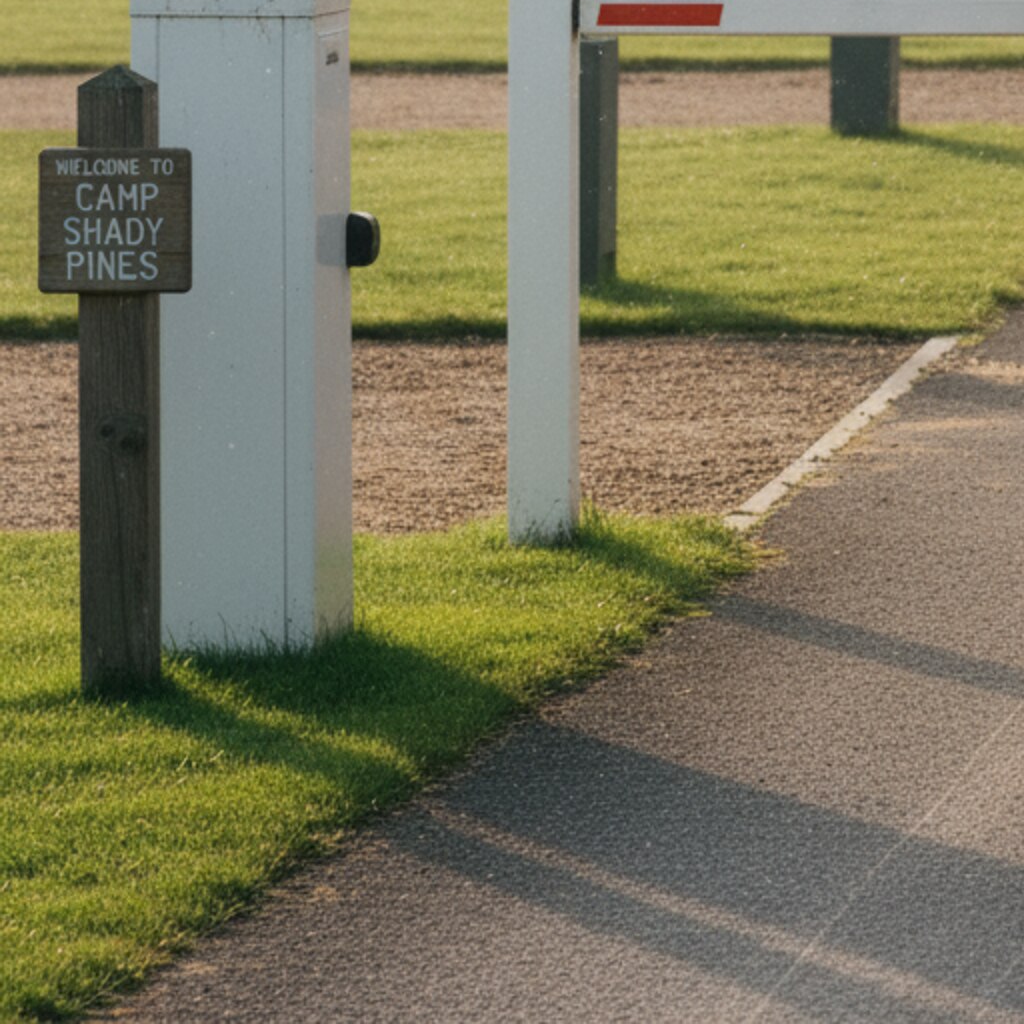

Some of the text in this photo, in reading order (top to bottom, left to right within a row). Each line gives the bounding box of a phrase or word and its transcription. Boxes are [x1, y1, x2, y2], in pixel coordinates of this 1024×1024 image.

[150, 158, 175, 176] TO
[75, 182, 159, 212] CAMP
[63, 216, 164, 246] SHADY
[66, 251, 159, 281] PINES
